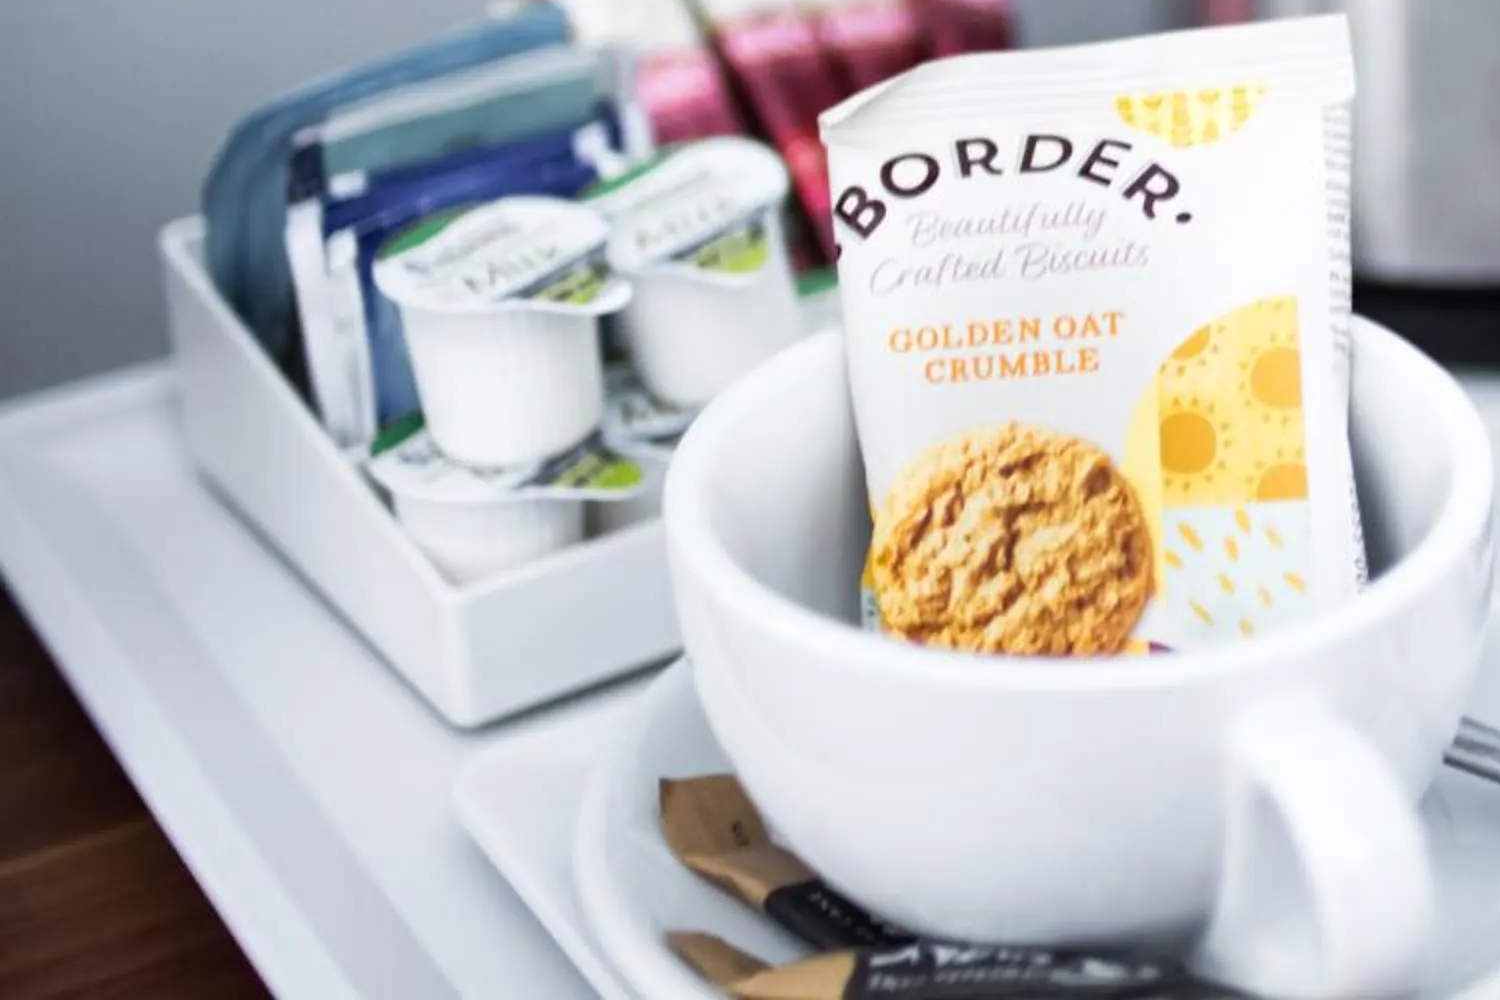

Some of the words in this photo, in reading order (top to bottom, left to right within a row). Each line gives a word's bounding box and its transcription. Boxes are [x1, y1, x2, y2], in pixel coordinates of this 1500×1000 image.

[909, 199, 1107, 248] Beautifully
[870, 250, 1005, 296] Crafted
[1018, 240, 1149, 283] Biscuits
[890, 315, 1041, 353] GOLDEN
[1054, 311, 1125, 339] OAT
[924, 350, 1099, 384] CRUMBLE
